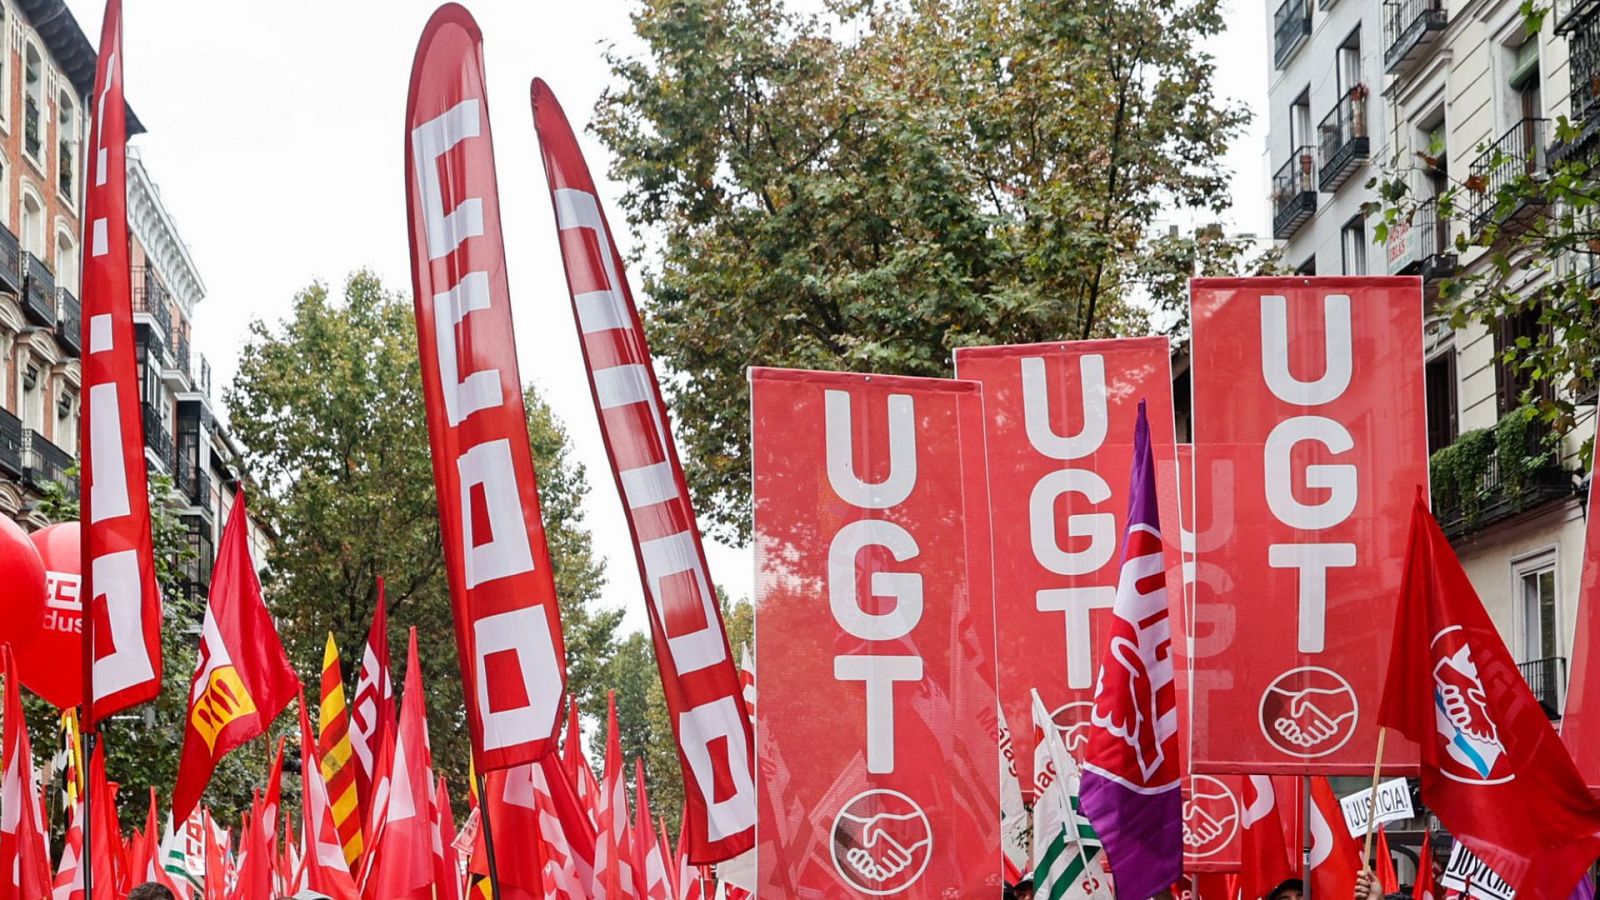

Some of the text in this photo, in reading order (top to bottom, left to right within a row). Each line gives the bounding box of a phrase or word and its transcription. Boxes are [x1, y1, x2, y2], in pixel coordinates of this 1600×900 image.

[411, 99, 564, 751] CCOO
[824, 389, 924, 774] UGT
[1021, 354, 1117, 690] UGT
[1260, 294, 1358, 653] UGT
